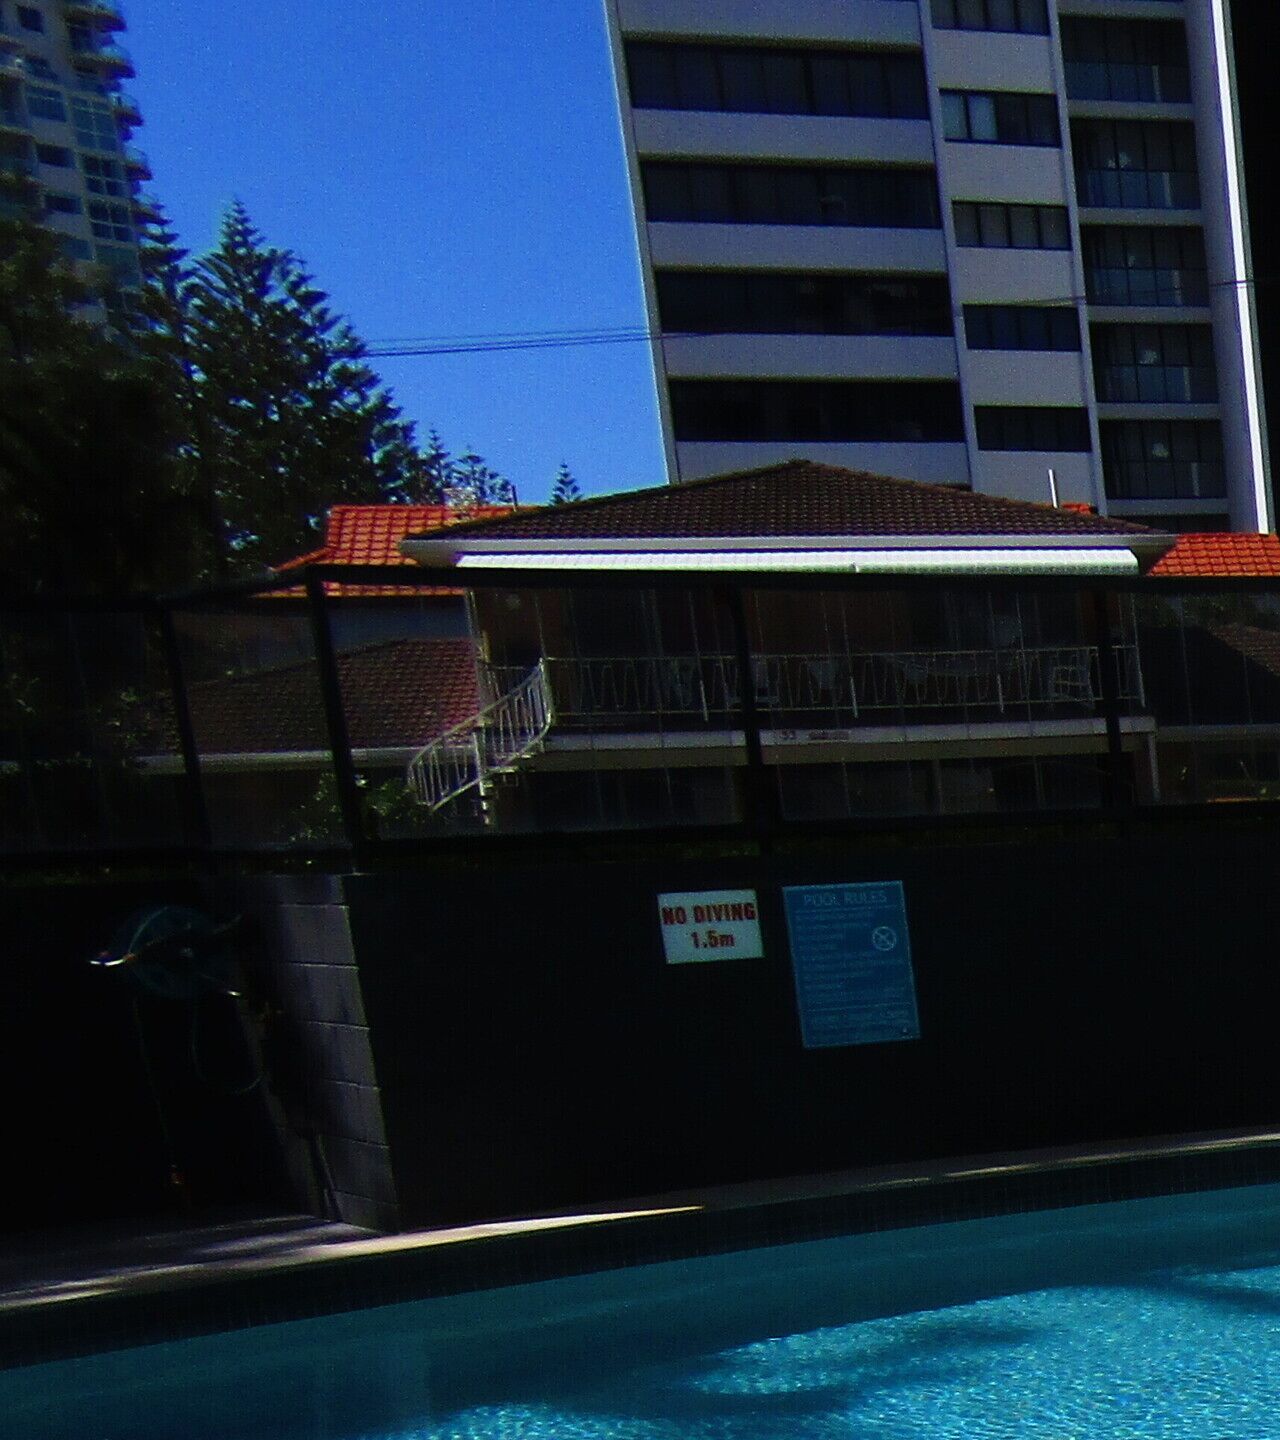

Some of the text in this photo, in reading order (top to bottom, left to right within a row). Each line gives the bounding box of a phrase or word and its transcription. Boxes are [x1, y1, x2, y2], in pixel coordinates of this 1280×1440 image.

[662, 903, 756, 925] NO DIVING
[691, 930, 735, 948] 1.5m
